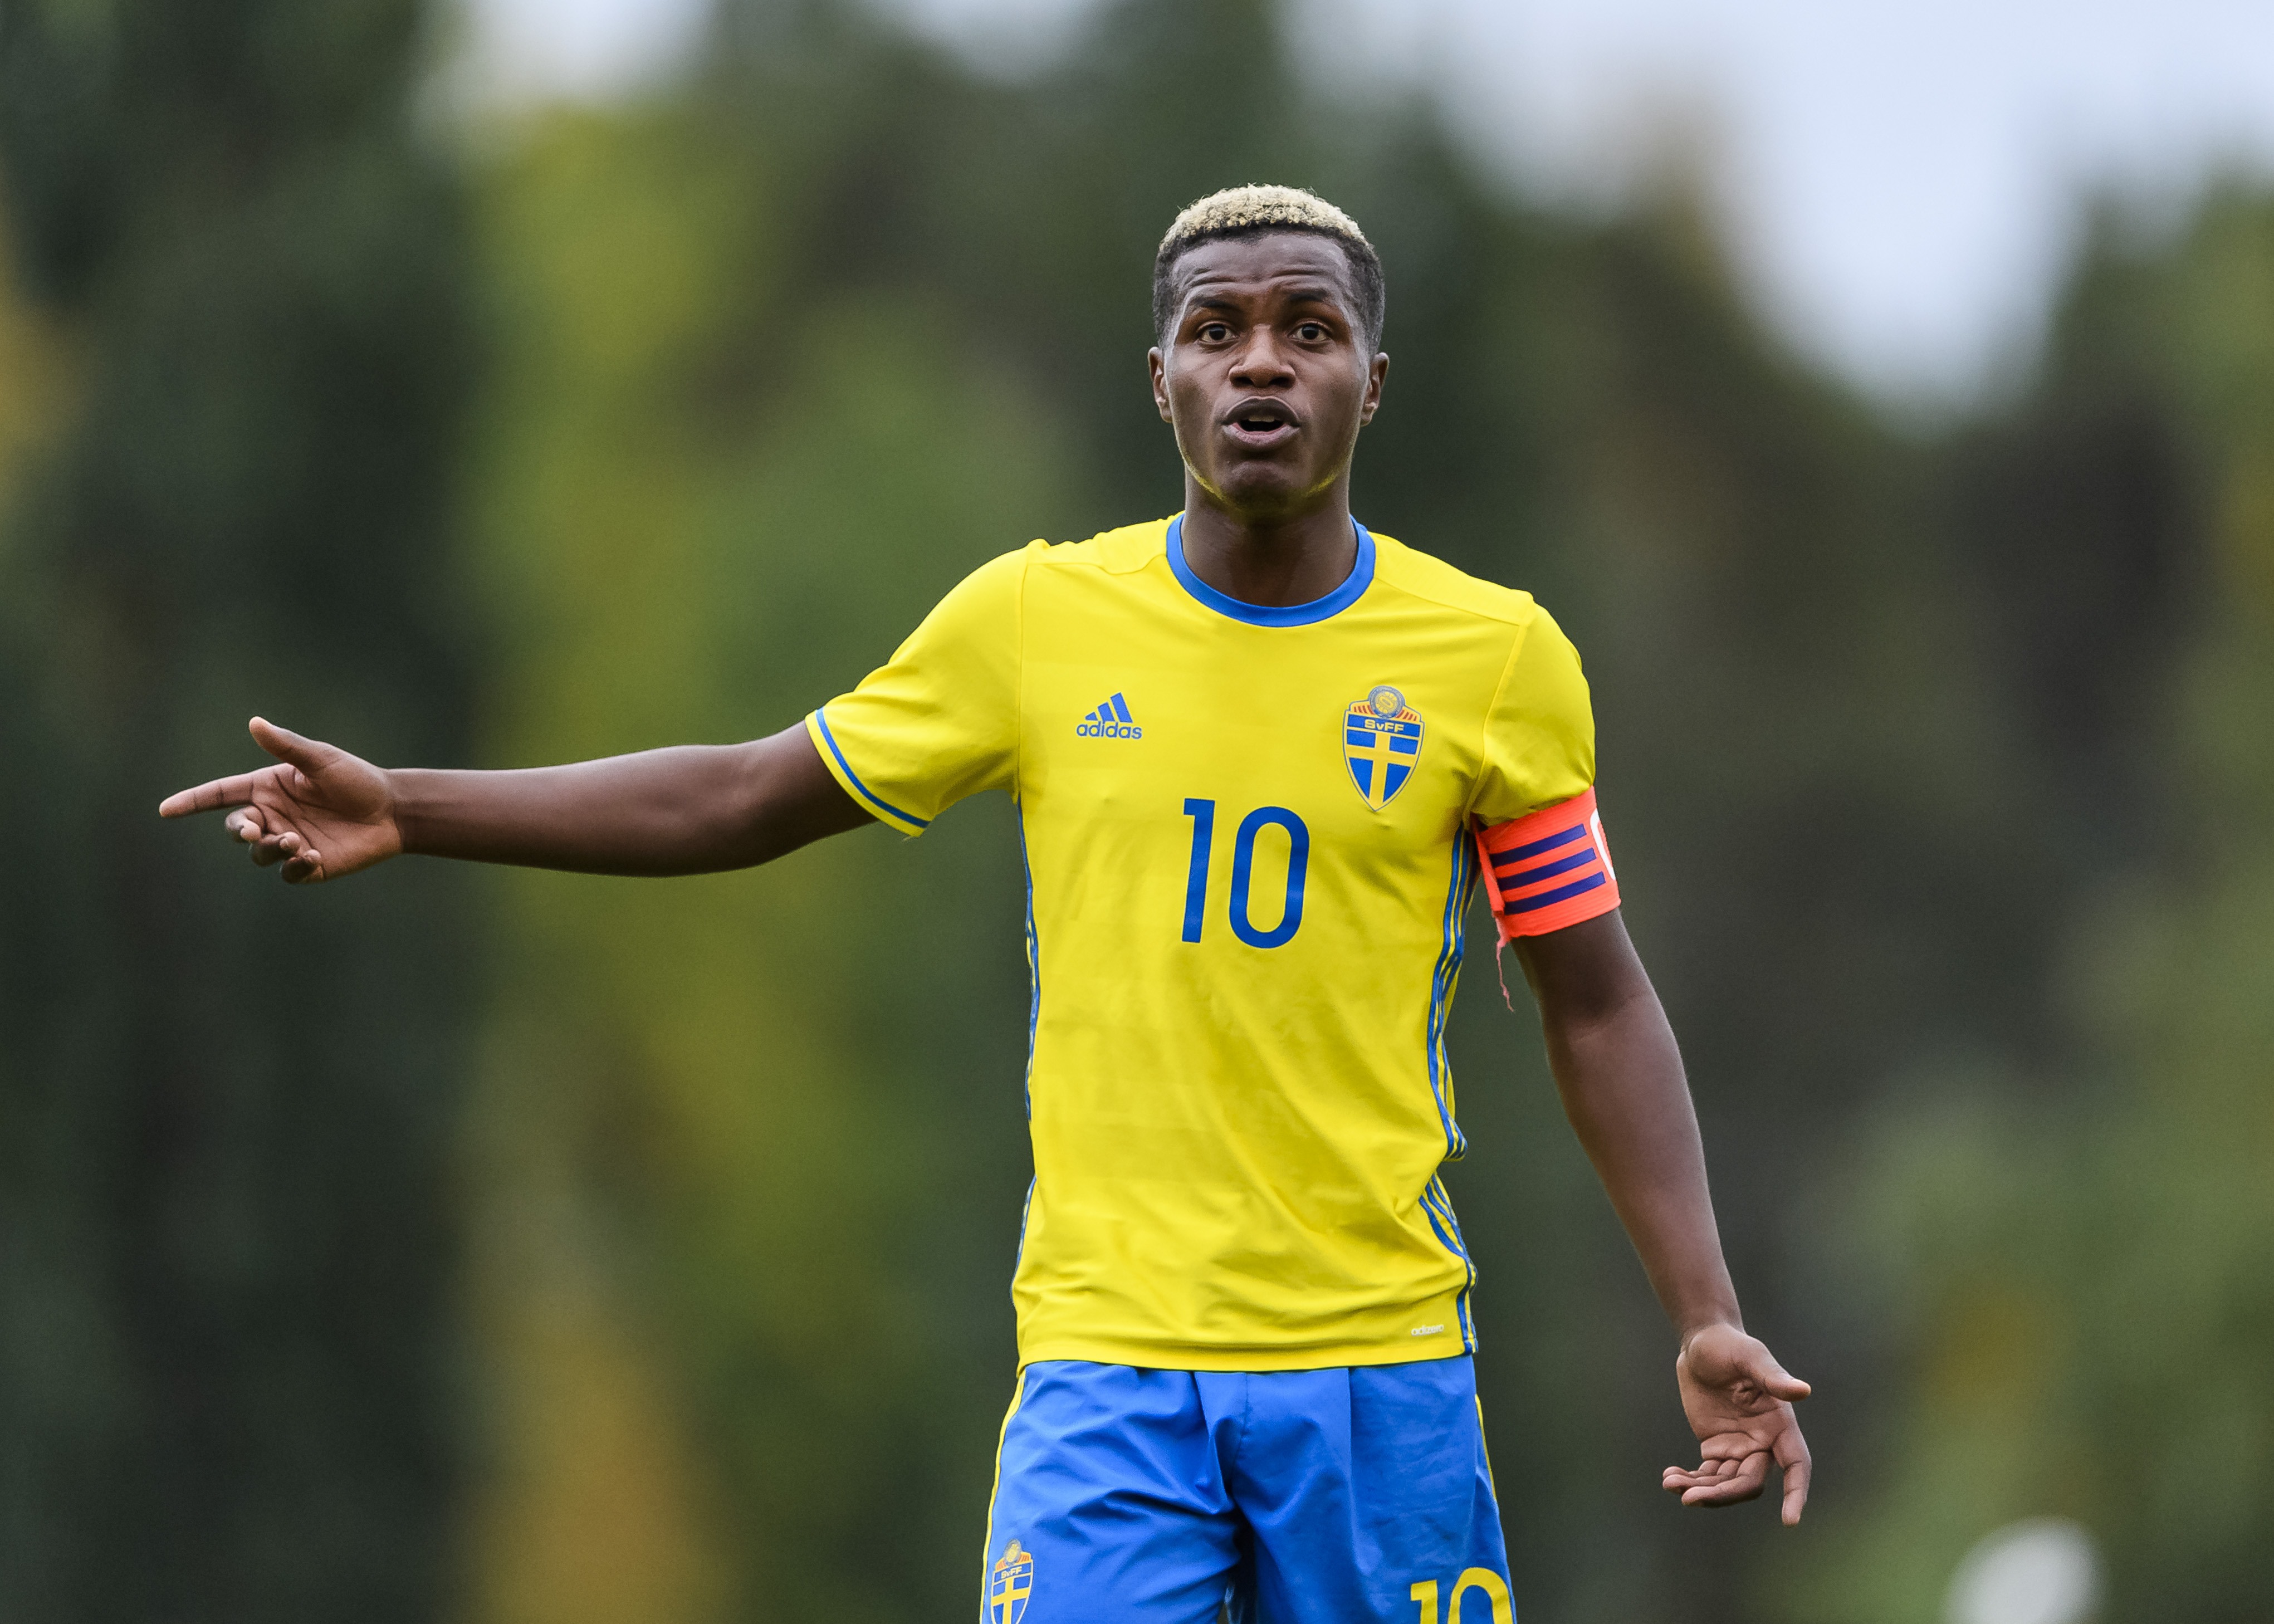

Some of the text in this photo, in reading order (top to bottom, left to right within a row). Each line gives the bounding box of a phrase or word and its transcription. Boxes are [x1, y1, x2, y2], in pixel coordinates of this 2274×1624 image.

[1077, 721, 1142, 739] adidas
[1365, 720, 1404, 732] SvFF
[1182, 798, 1310, 948] 10
